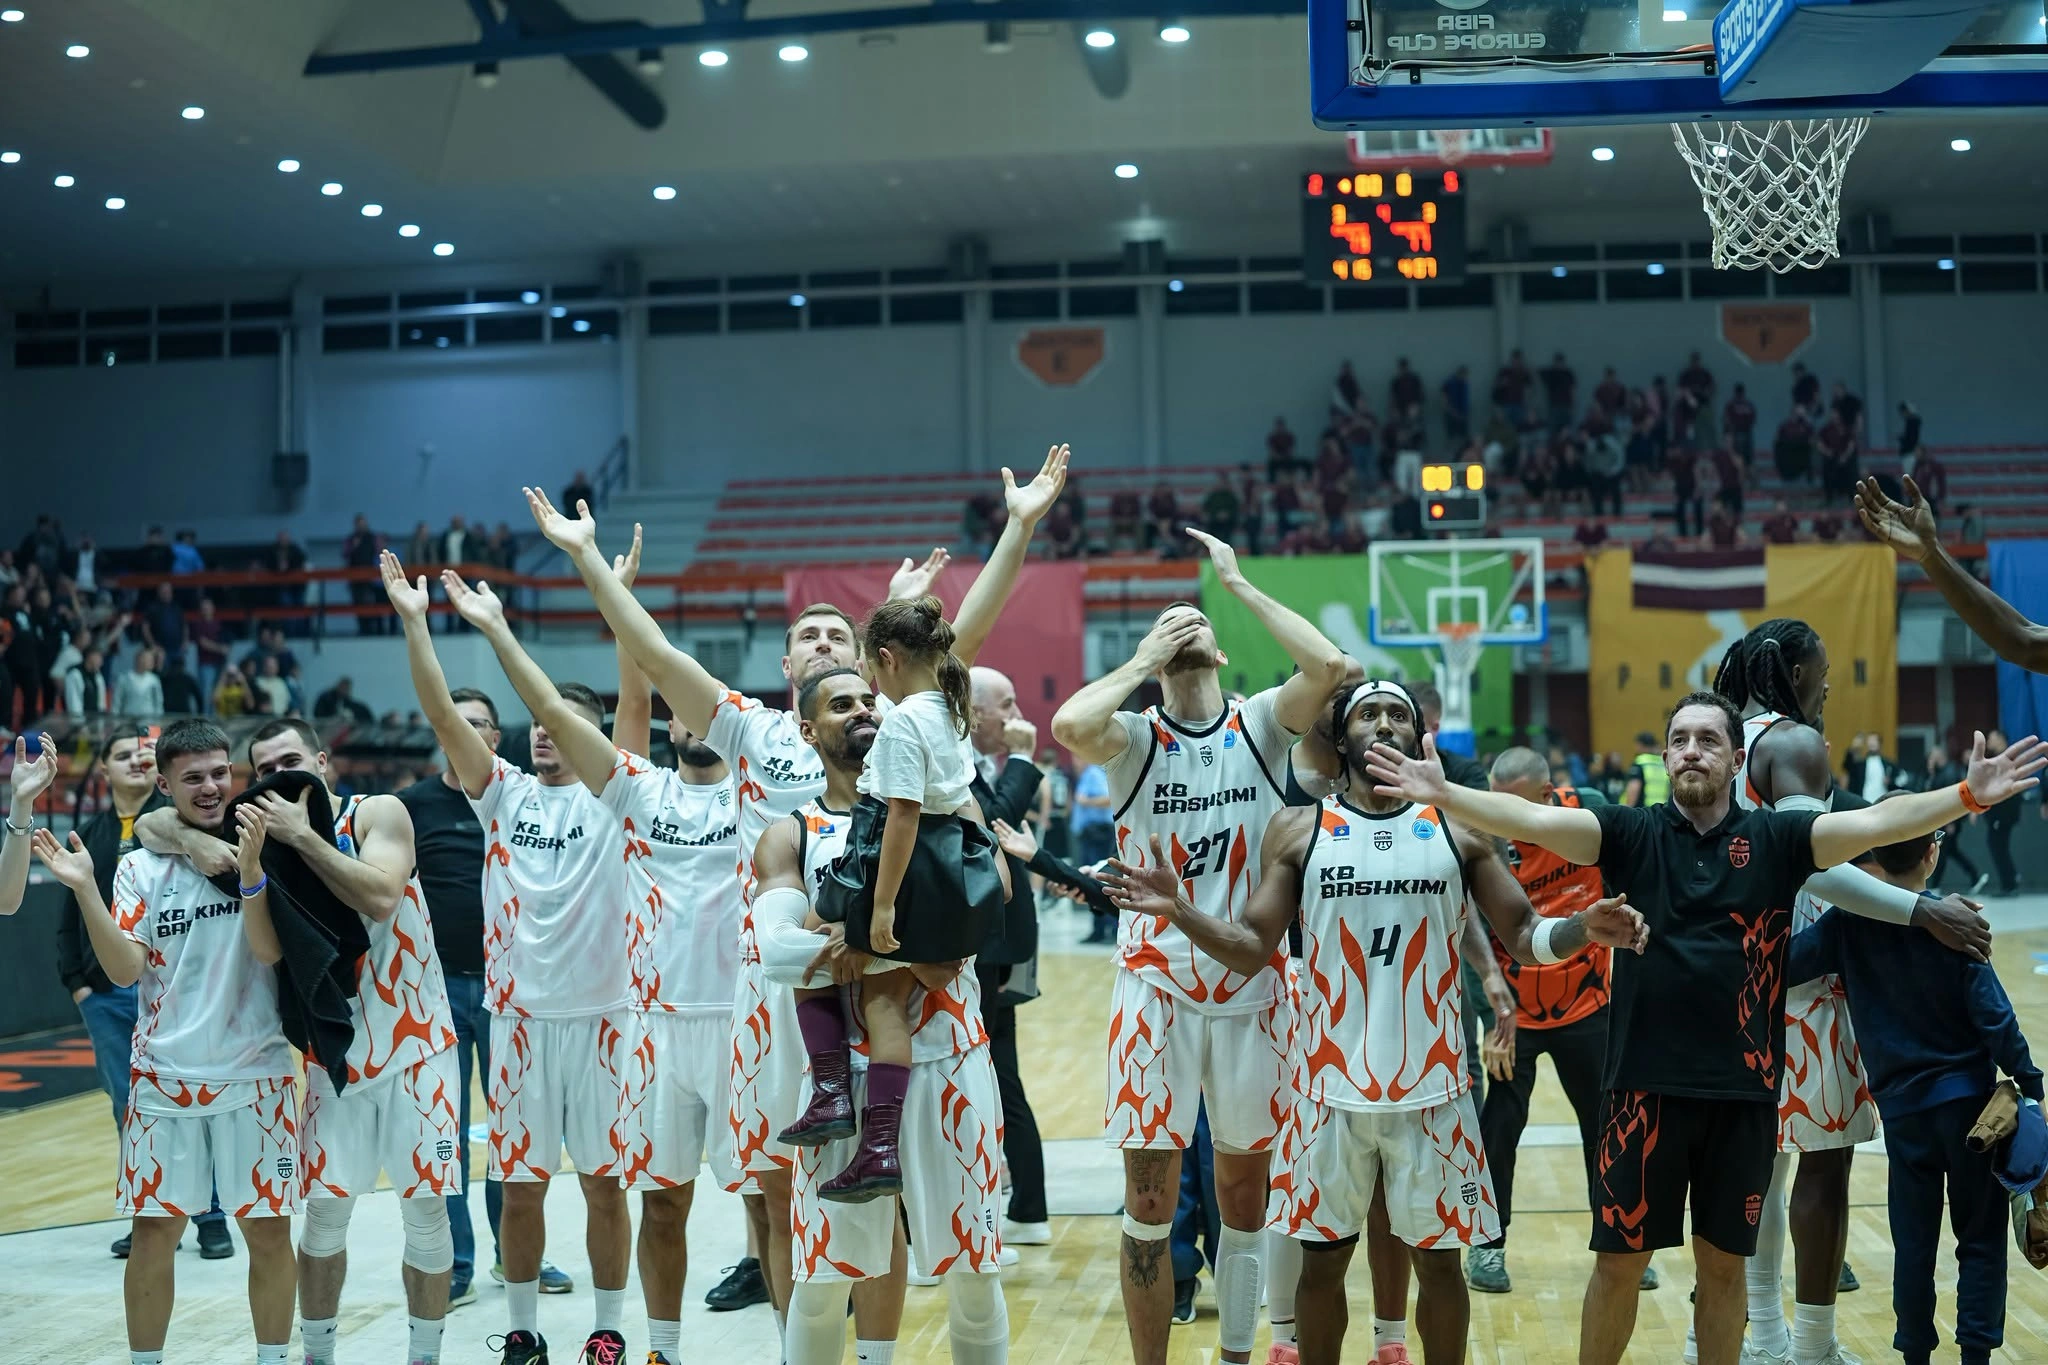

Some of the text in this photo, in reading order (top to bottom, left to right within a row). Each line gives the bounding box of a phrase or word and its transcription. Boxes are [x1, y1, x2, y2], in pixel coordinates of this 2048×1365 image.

[1152, 786, 1257, 815] BASHKIMI
[1154, 783, 1188, 799] KB
[510, 825, 584, 852] BASHKMI
[515, 821, 541, 836] KB
[650, 823, 737, 846] BASHKIM
[1180, 827, 1231, 883] 27
[1320, 865, 1355, 882] KB
[1320, 879, 1448, 900] BASHKIMI
[156, 900, 241, 938] BAKIMI
[158, 908, 186, 924] KB
[1368, 923, 1402, 967] 4
